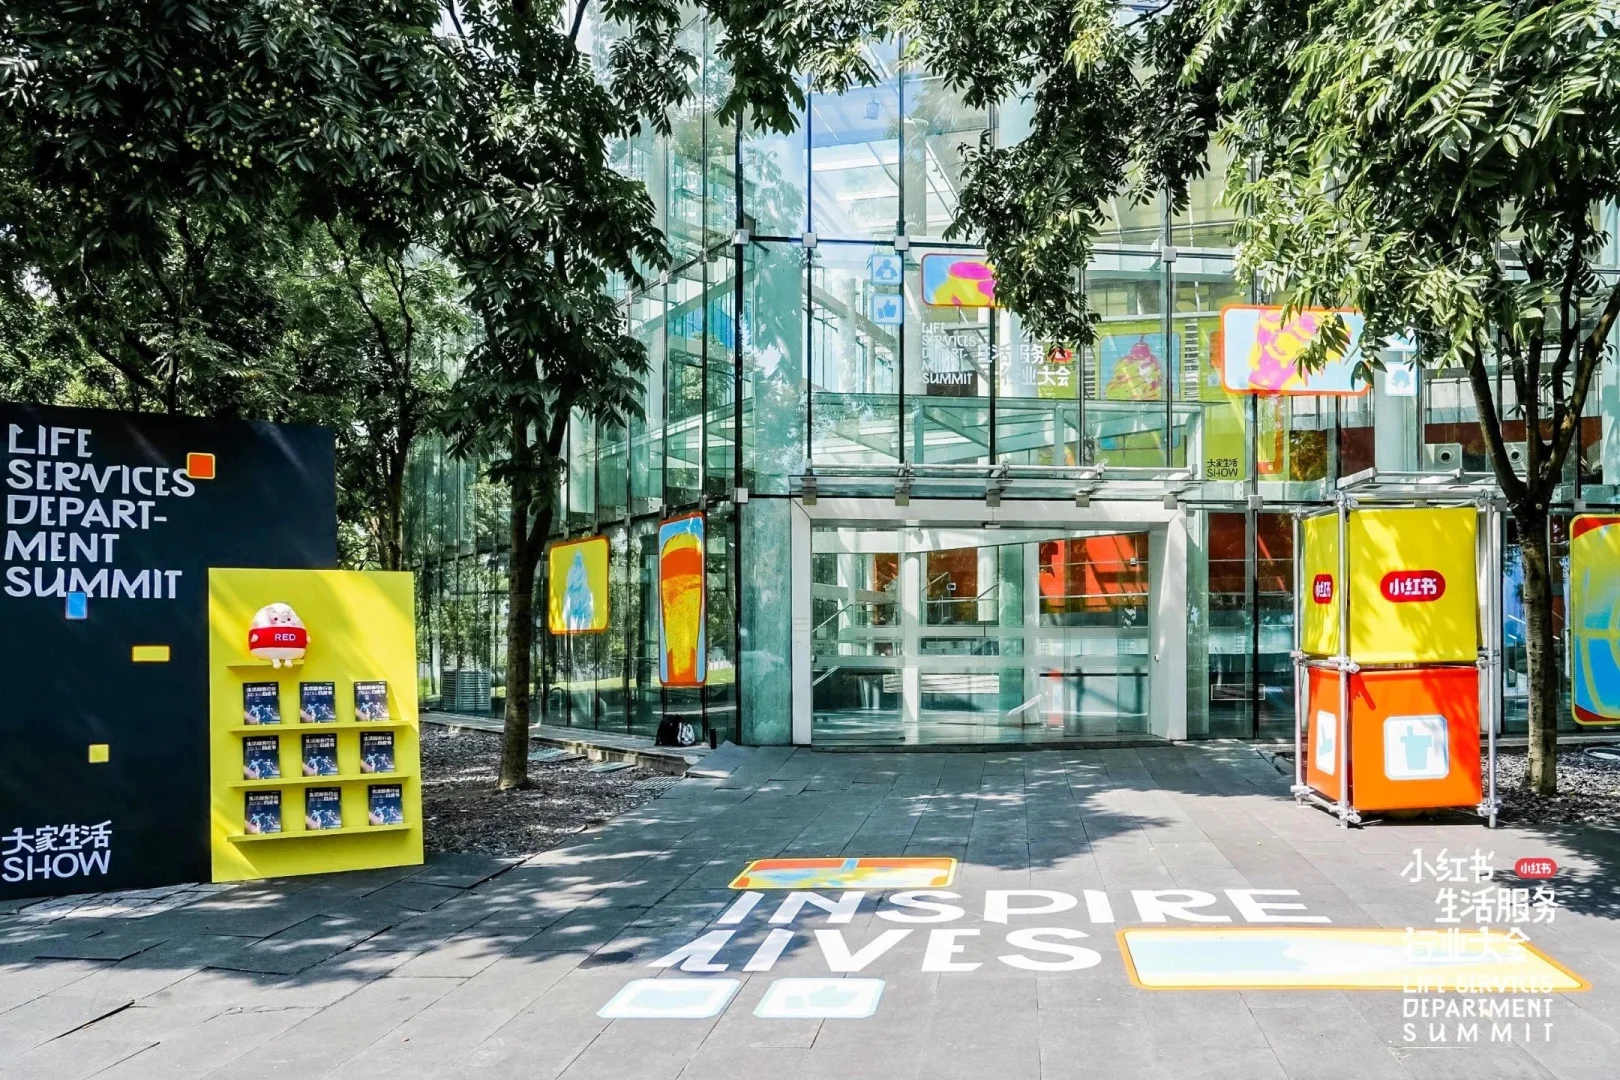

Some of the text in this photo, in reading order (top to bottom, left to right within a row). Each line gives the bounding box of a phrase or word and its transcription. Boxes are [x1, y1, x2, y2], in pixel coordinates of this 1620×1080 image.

[922, 372, 973, 385] SUMMIT
[8, 423, 93, 458] LIFE
[6, 459, 196, 498] SERVICES
[1206, 457, 1239, 468] 大家生活
[1206, 467, 1239, 478] SHOW
[7, 494, 168, 530] DEPART-
[4, 530, 120, 563] MENT
[4, 566, 183, 599] SUMMIT
[1389, 577, 1437, 596] 小红书
[274, 633, 296, 641] RED
[2, 820, 113, 855] 大家生活
[2, 850, 111, 882] SHOW
[716, 889, 1333, 925] INSPIRE
[644, 927, 1102, 972] LIVES
